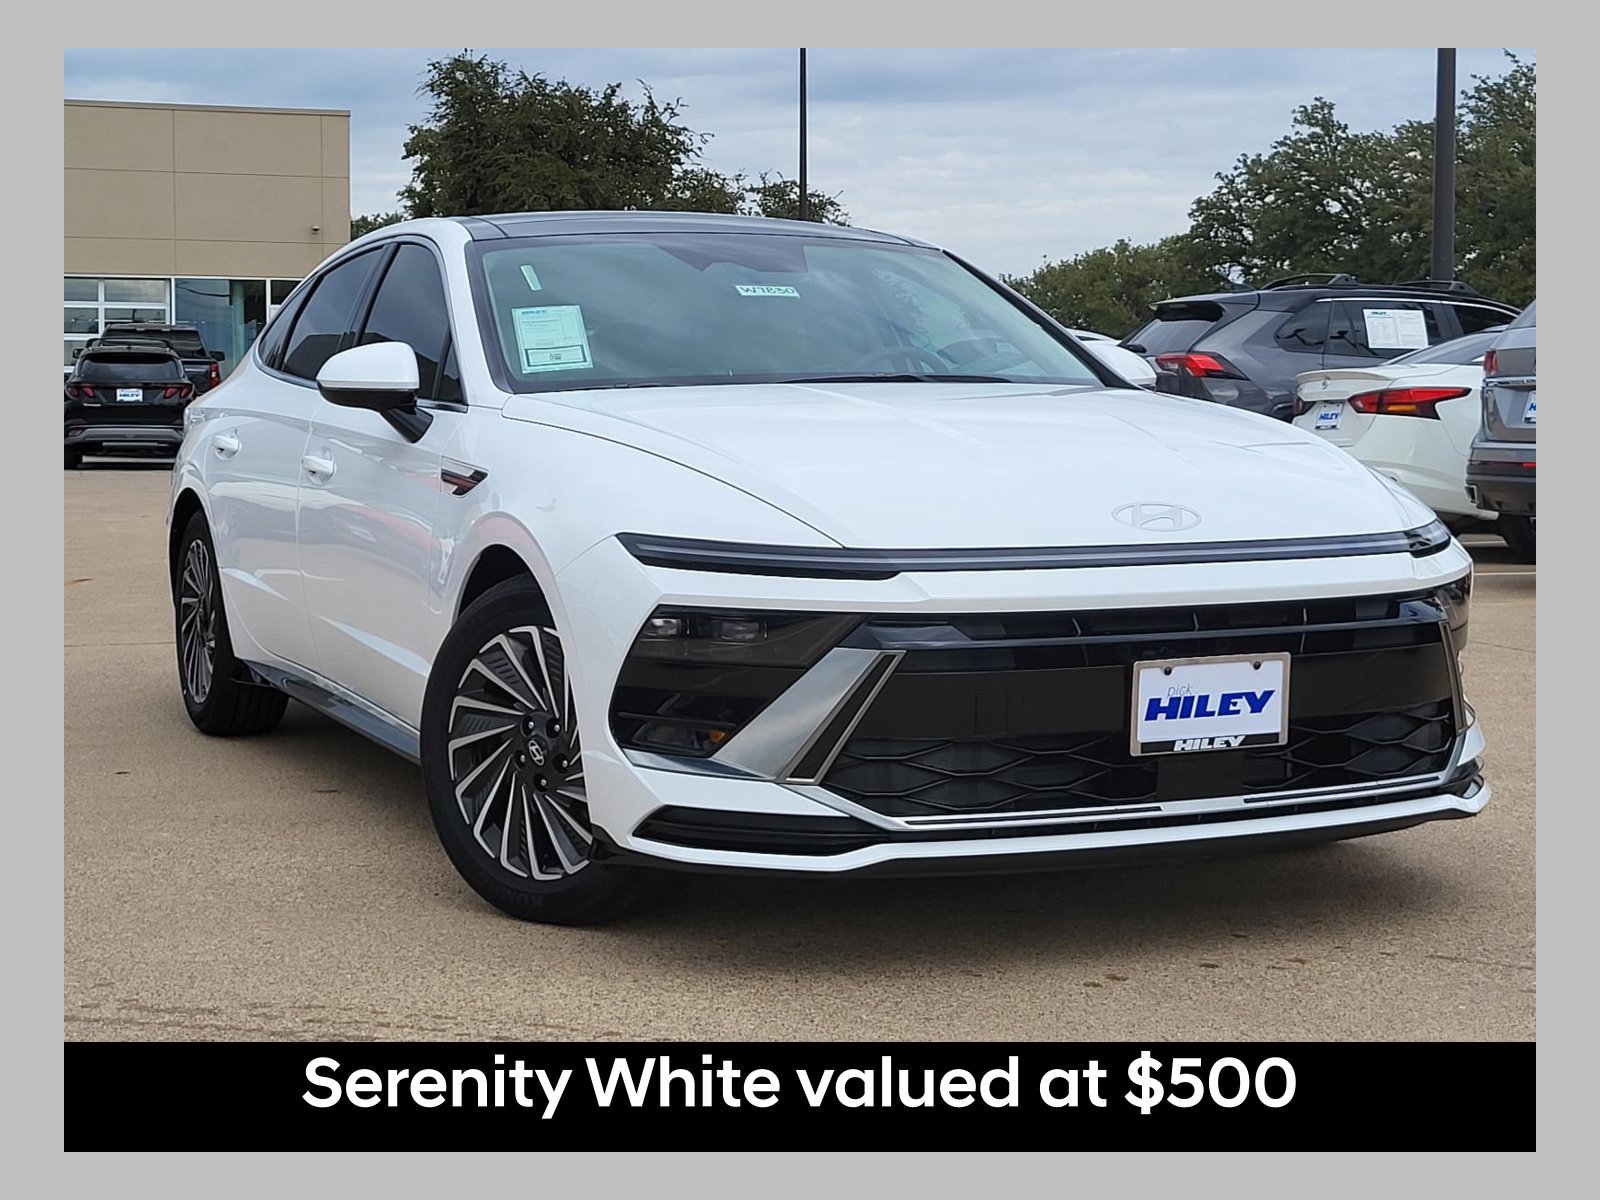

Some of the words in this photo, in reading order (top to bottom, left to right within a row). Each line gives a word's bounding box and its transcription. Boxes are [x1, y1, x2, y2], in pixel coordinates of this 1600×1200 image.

[1318, 412, 1340, 421] HILEY
[1166, 683, 1194, 698] pick
[1144, 689, 1276, 722] HILEY
[1173, 735, 1246, 752] HILEY
